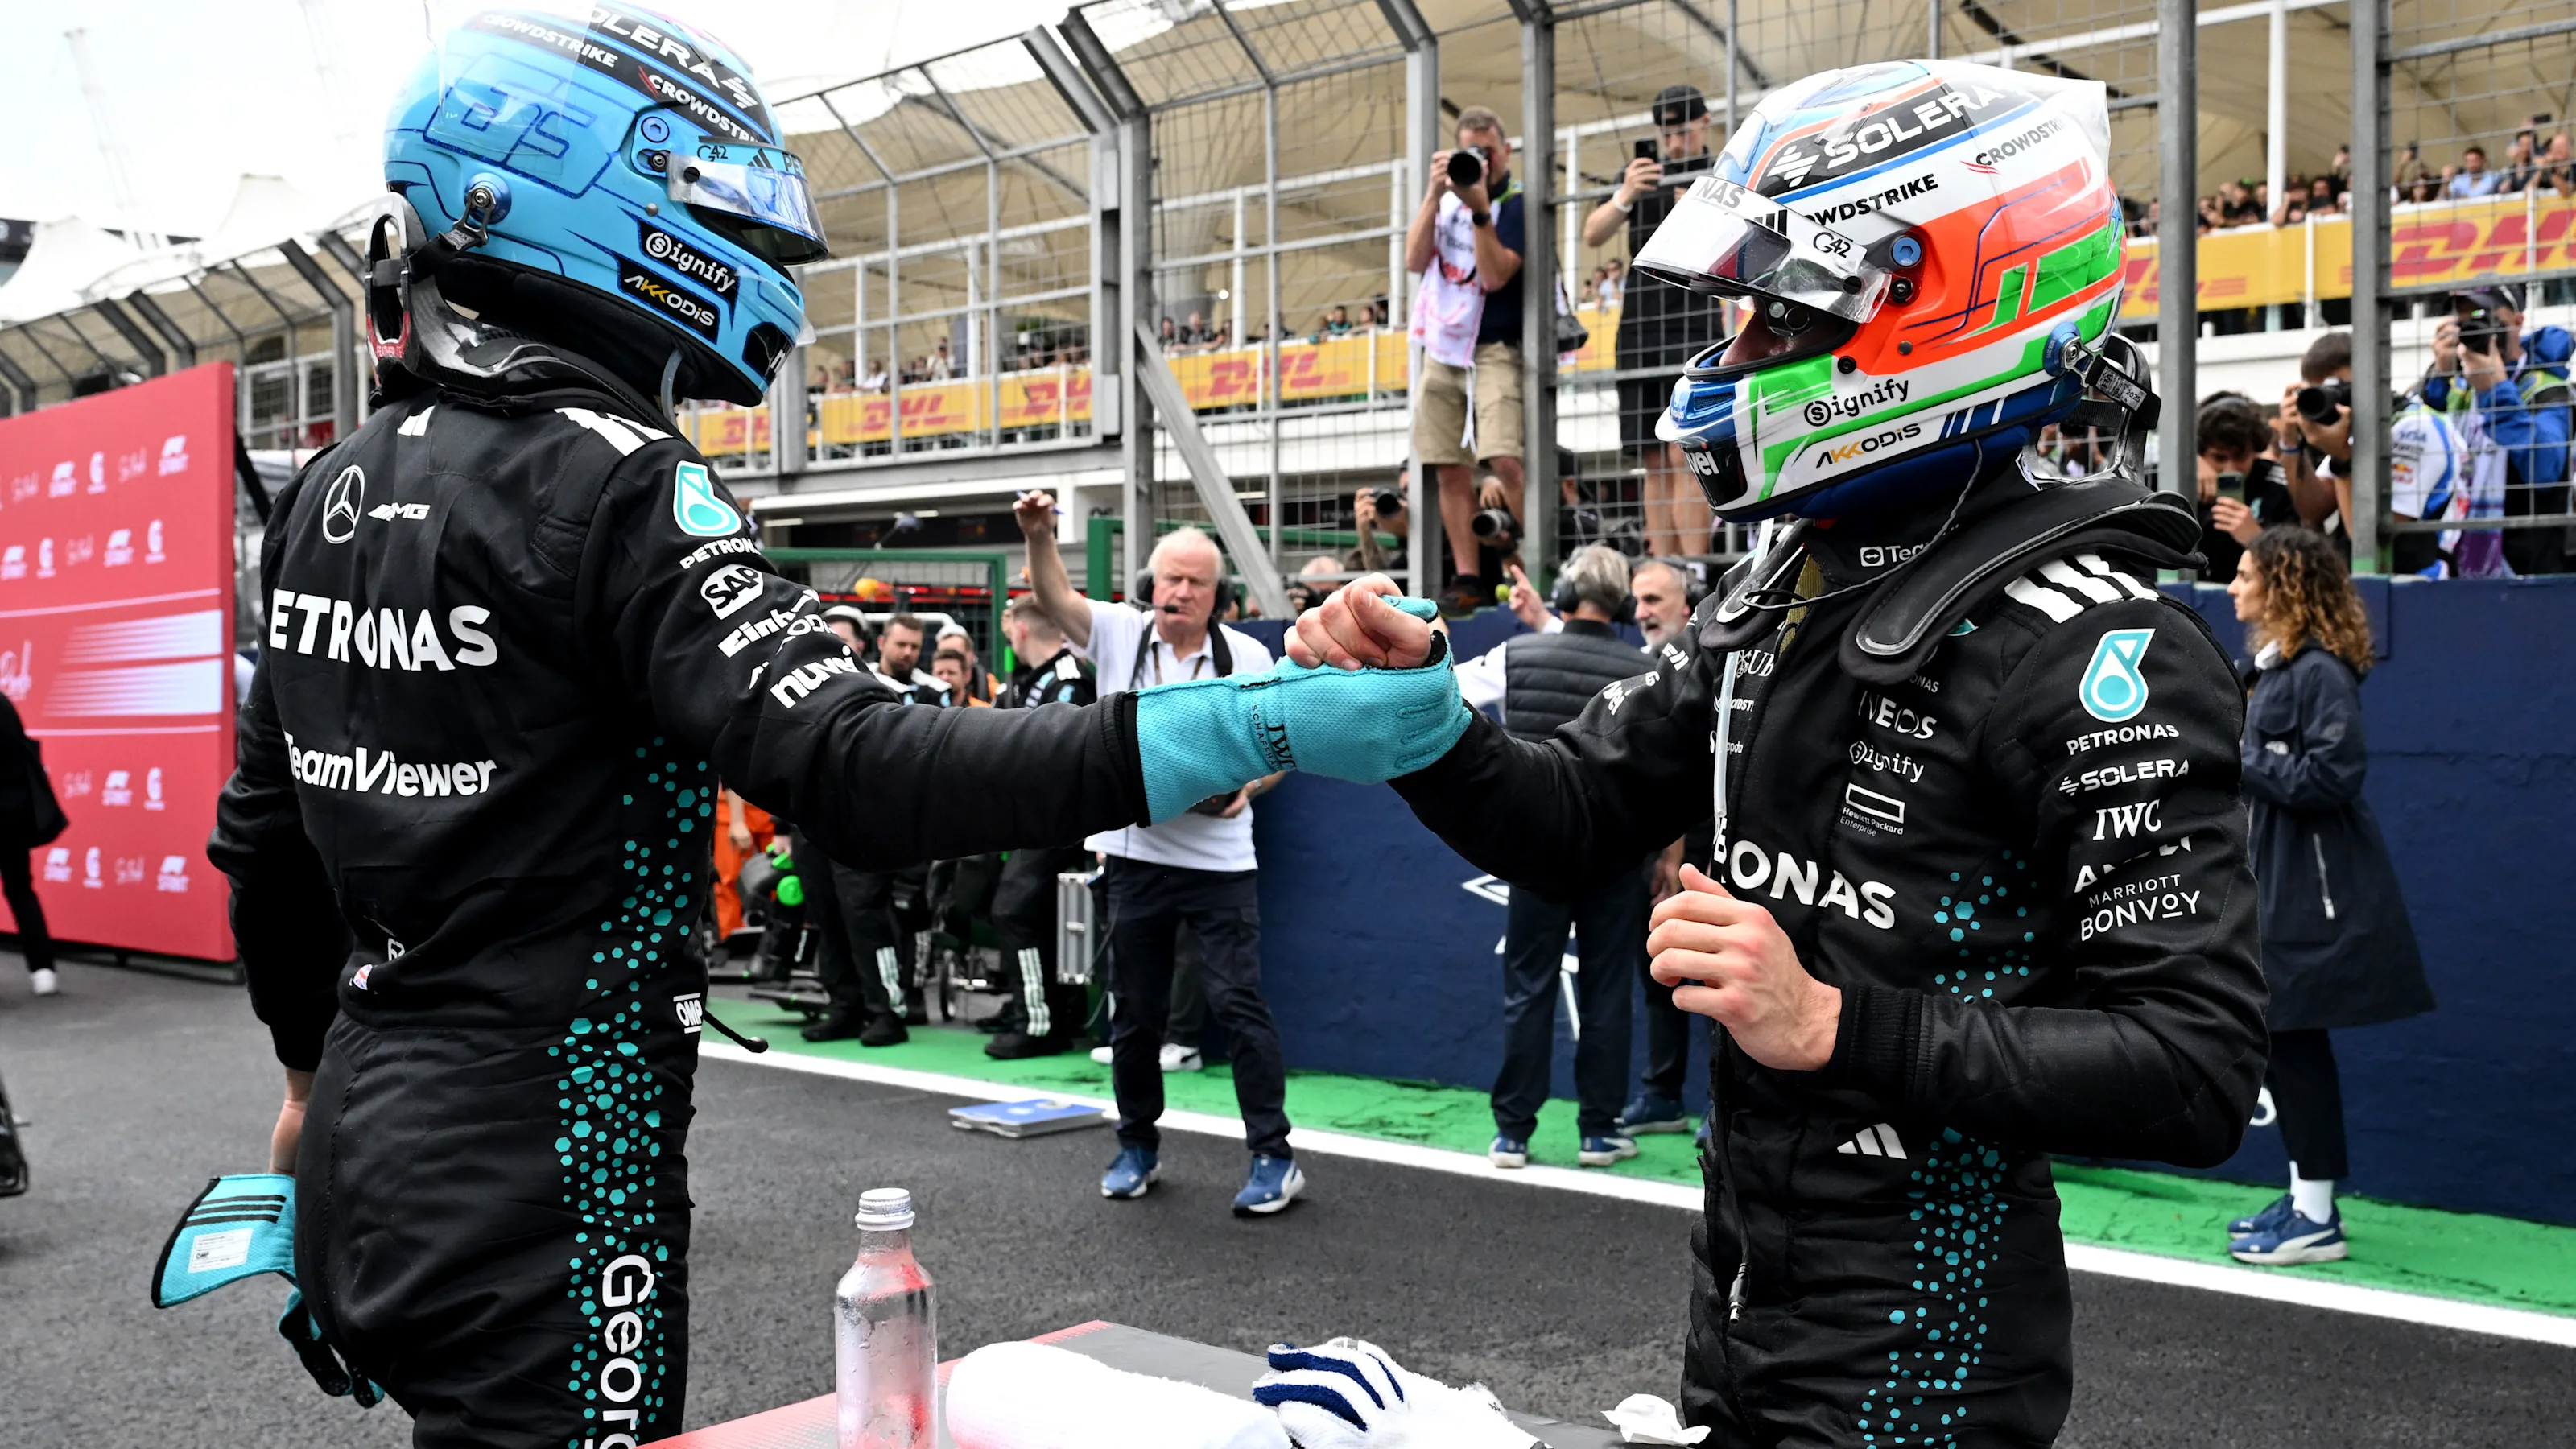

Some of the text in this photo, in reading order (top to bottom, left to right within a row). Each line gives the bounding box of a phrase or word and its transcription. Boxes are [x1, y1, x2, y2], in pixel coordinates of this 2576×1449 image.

[483, 14, 618, 68] CROWDSTRIKE
[589, 6, 721, 89] OLERA
[1823, 84, 2007, 169] SOLERA
[1805, 172, 1938, 227] WDSTRIKE
[645, 232, 736, 292] signify
[1812, 231, 1852, 258] G42
[1804, 378, 1910, 427] signify
[2125, 389, 2142, 403] 2025
[679, 537, 761, 570] PETRON
[704, 568, 760, 610] SAP
[769, 645, 860, 709] nuvei
[2066, 723, 2180, 756] PETRONAS
[284, 731, 497, 797] TeamViewer
[1849, 740, 1925, 784] signify
[2079, 758, 2190, 792] SOLERA
[1839, 815, 1877, 837] Enterprise
[1842, 807, 1904, 836] Hewlett Packard
[2092, 798, 2162, 841] IWC
[1715, 823, 1897, 930] ONAS
[2088, 873, 2181, 909] MARRIOTT
[2080, 890, 2201, 942] BONVOY
[675, 997, 703, 1027] OMP
